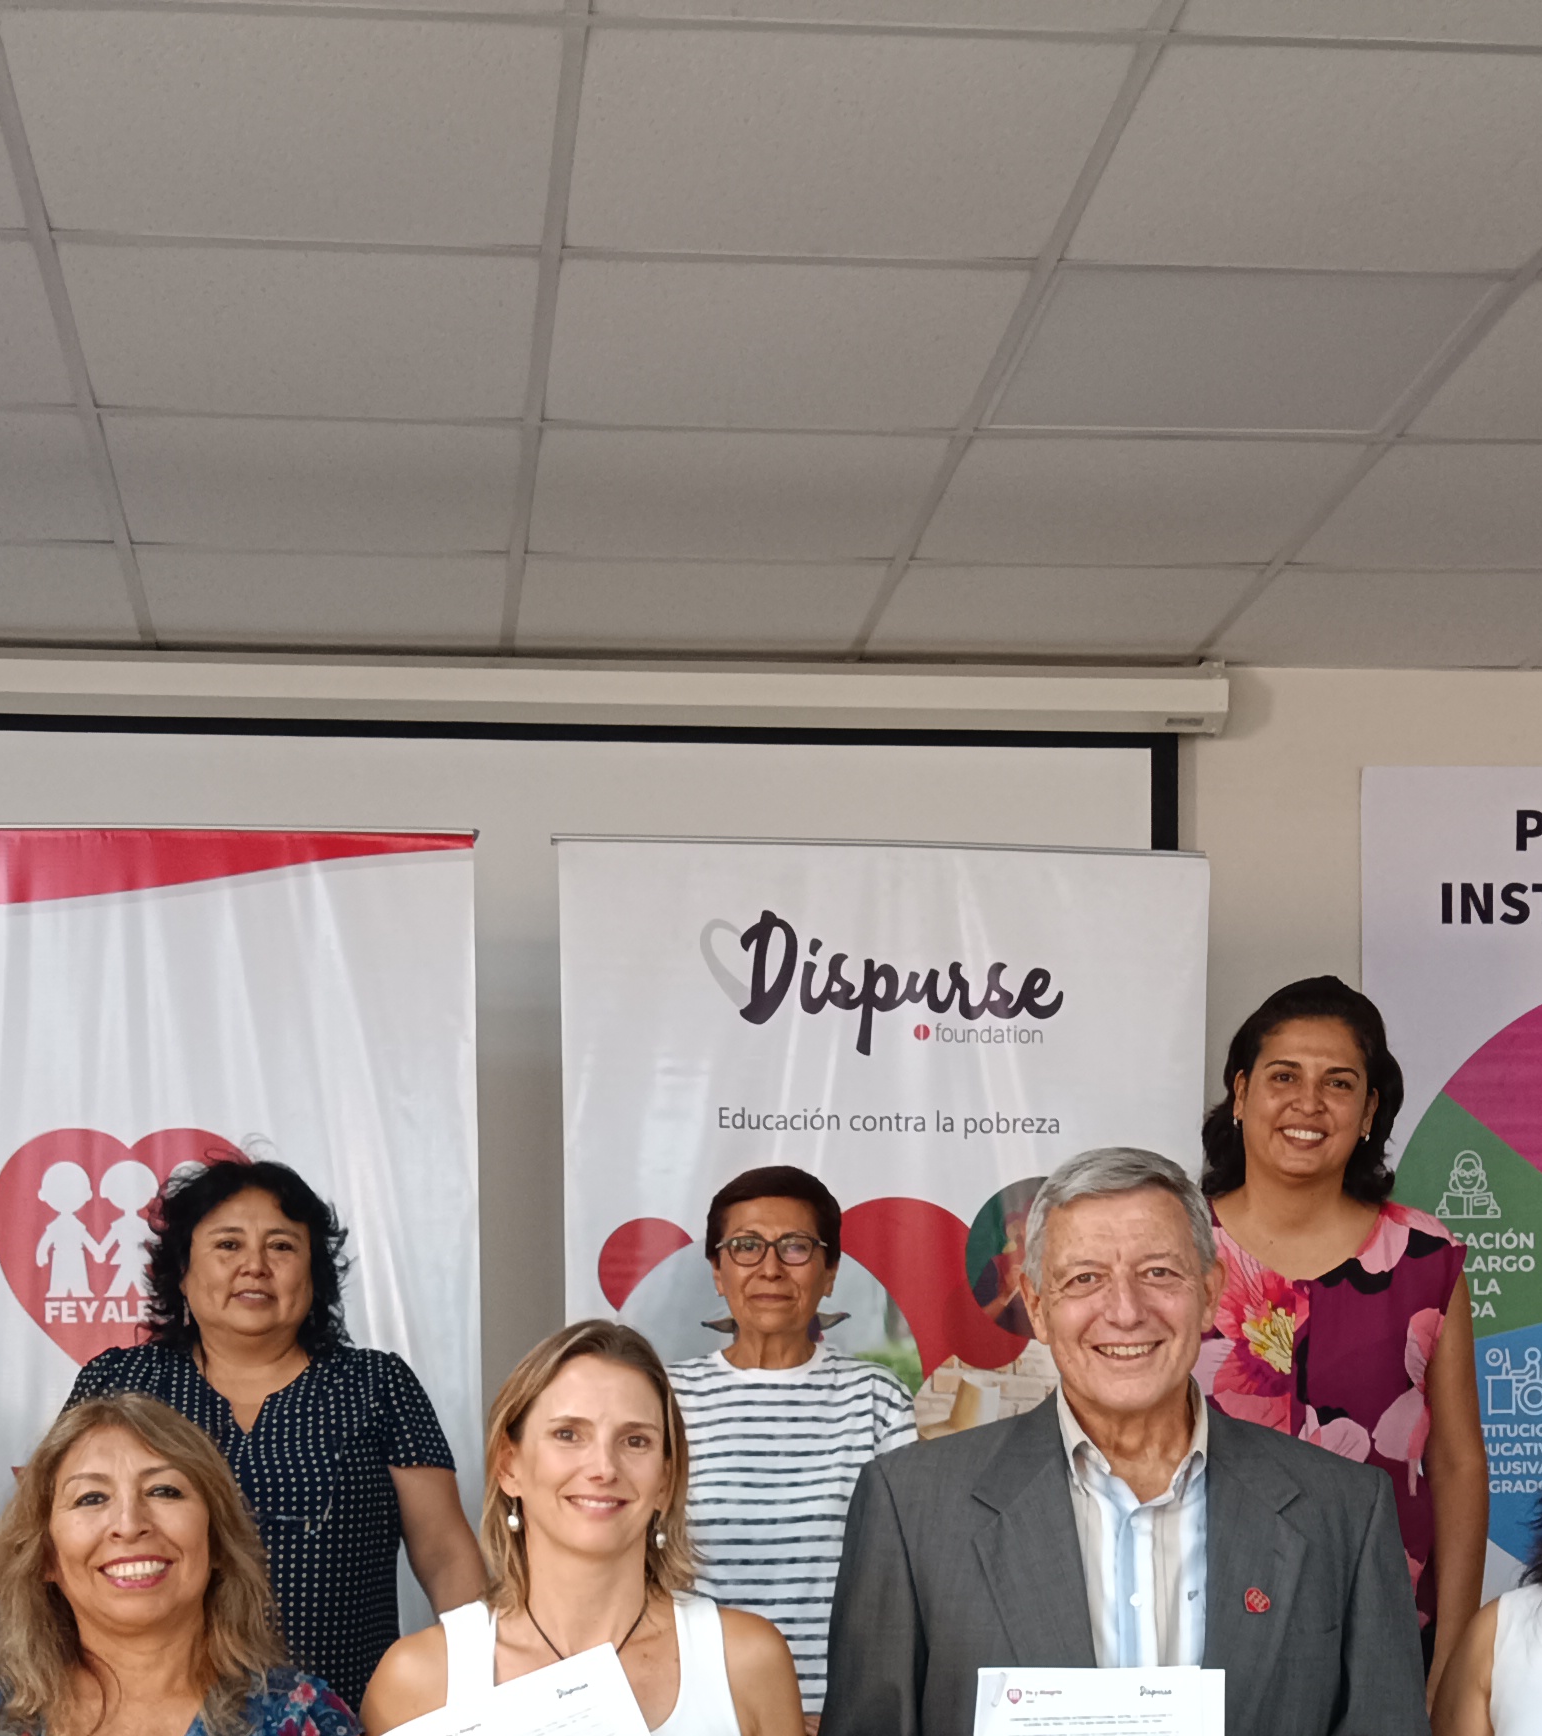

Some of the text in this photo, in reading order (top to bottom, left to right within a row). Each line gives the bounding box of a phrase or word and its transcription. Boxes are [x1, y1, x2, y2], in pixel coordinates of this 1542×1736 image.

[739, 910, 1064, 1056] Dispurse
[935, 1023, 1044, 1045] foundation
[718, 1107, 1061, 1139] Educación contra la pobreza
[1473, 1278, 1502, 1296] LA
[44, 1301, 78, 1323] FE
[79, 1301, 99, 1323] Y
